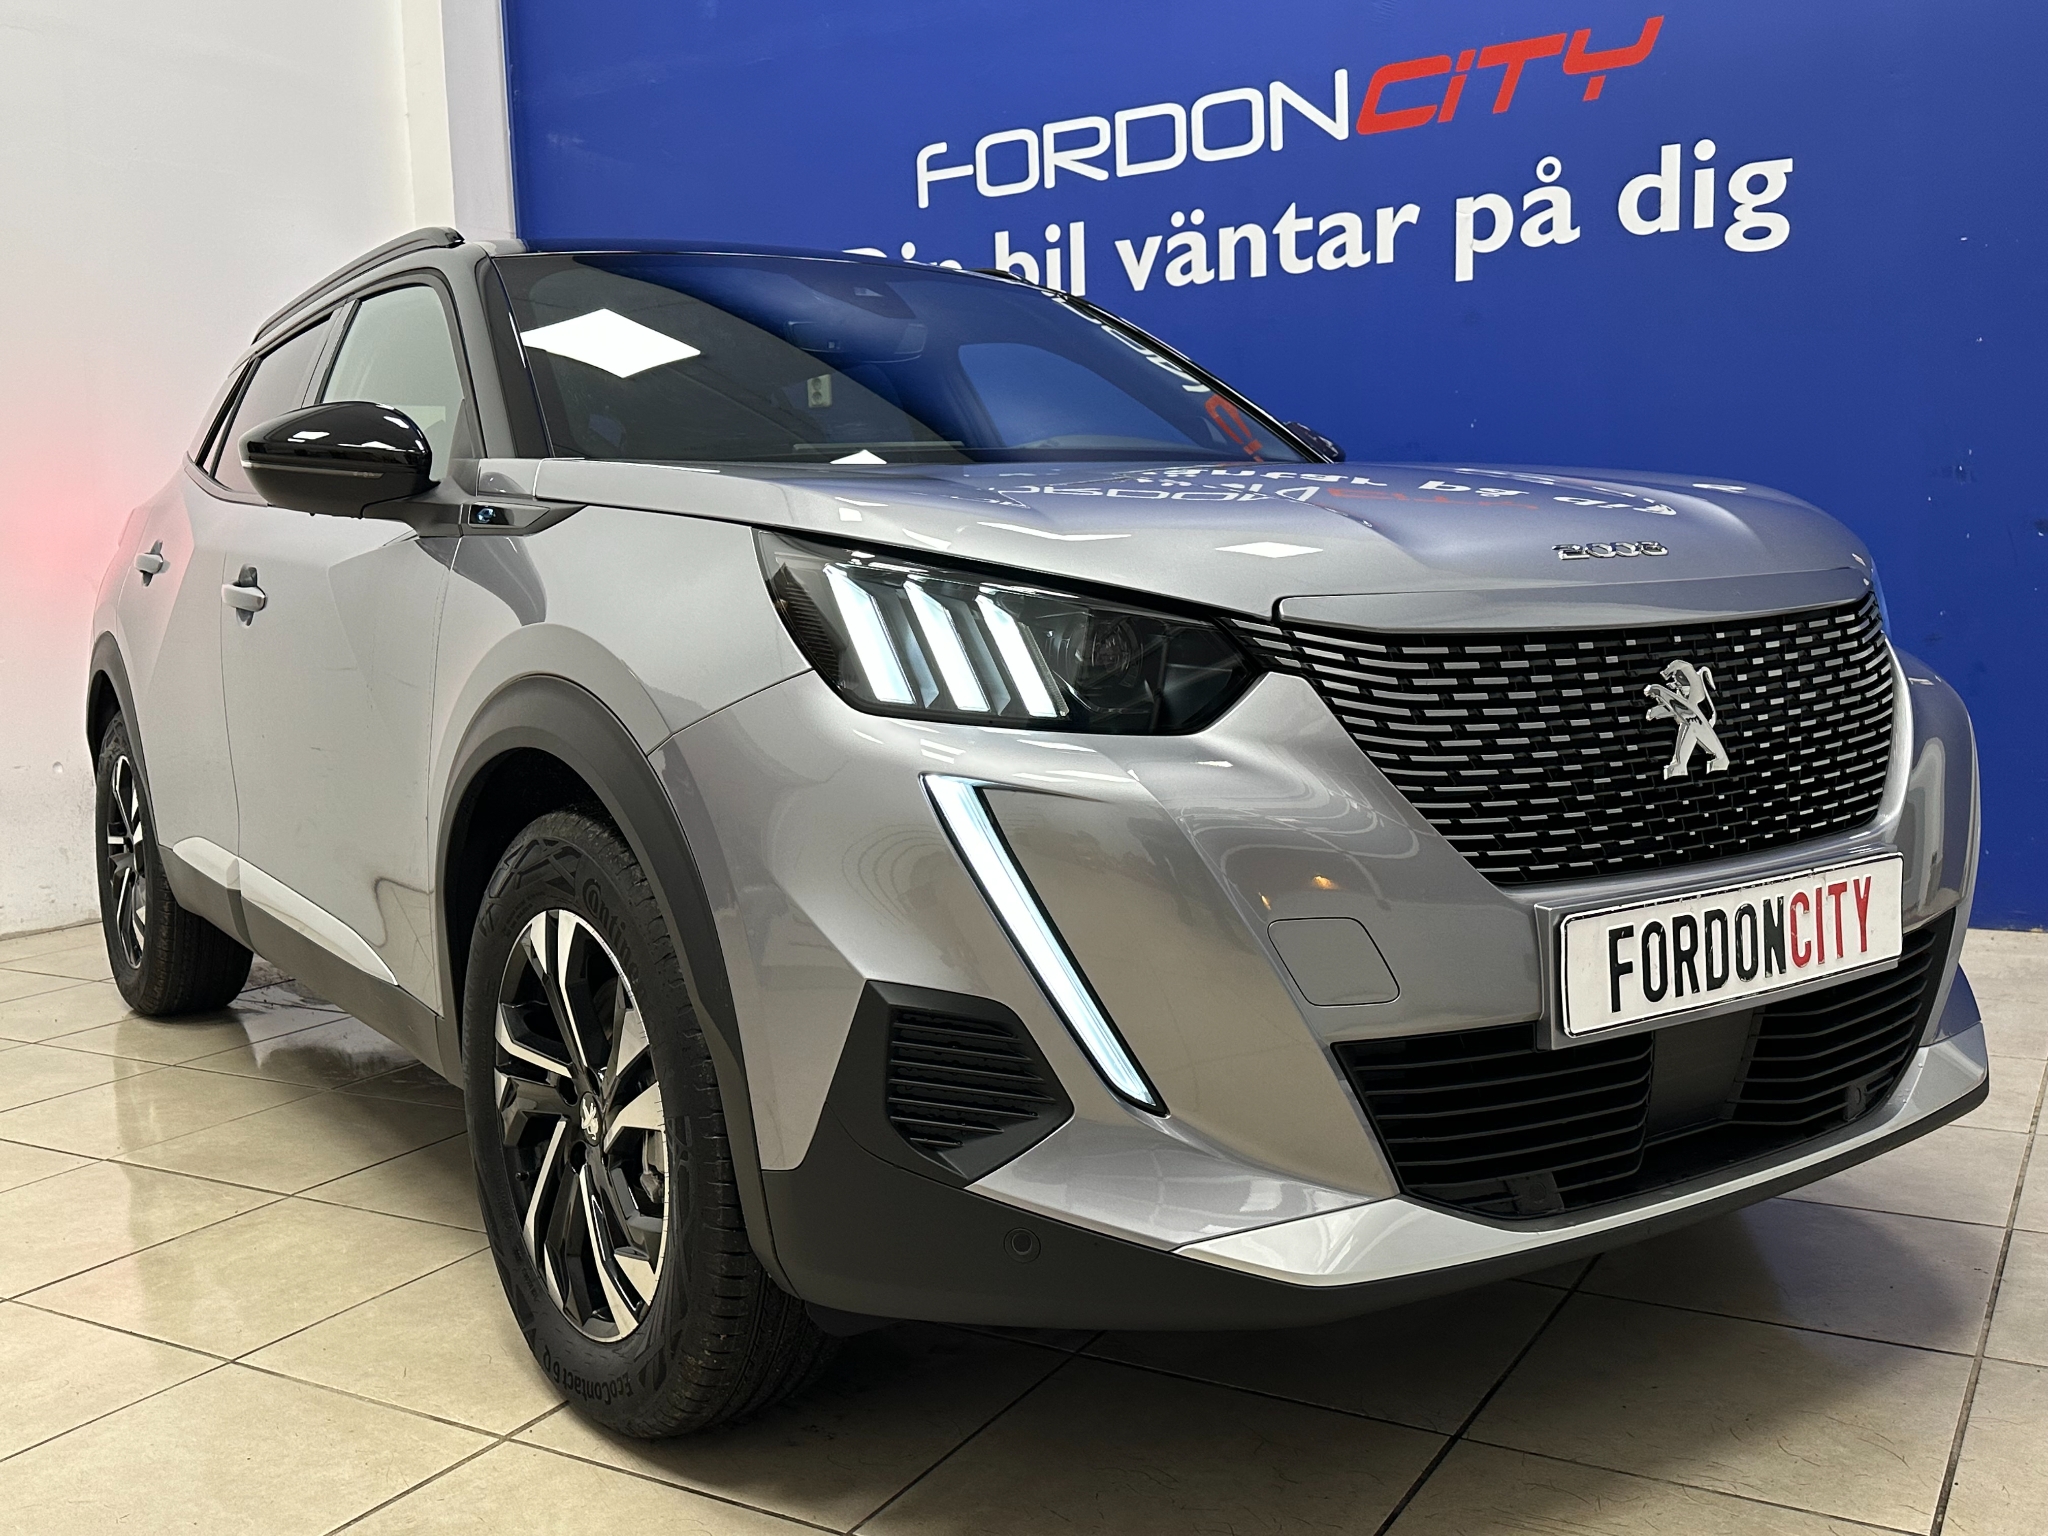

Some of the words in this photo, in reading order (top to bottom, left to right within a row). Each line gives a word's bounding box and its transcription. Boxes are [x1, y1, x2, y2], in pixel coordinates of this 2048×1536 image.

[993, 220, 1087, 297] bil
[1113, 201, 1422, 292] väntar
[1454, 155, 1582, 284] på
[1616, 139, 1795, 254] dig
[1551, 540, 1668, 560] 2008
[1608, 875, 1872, 1014] FORDONCITY
[562, 1367, 634, 1406] EcoContact
